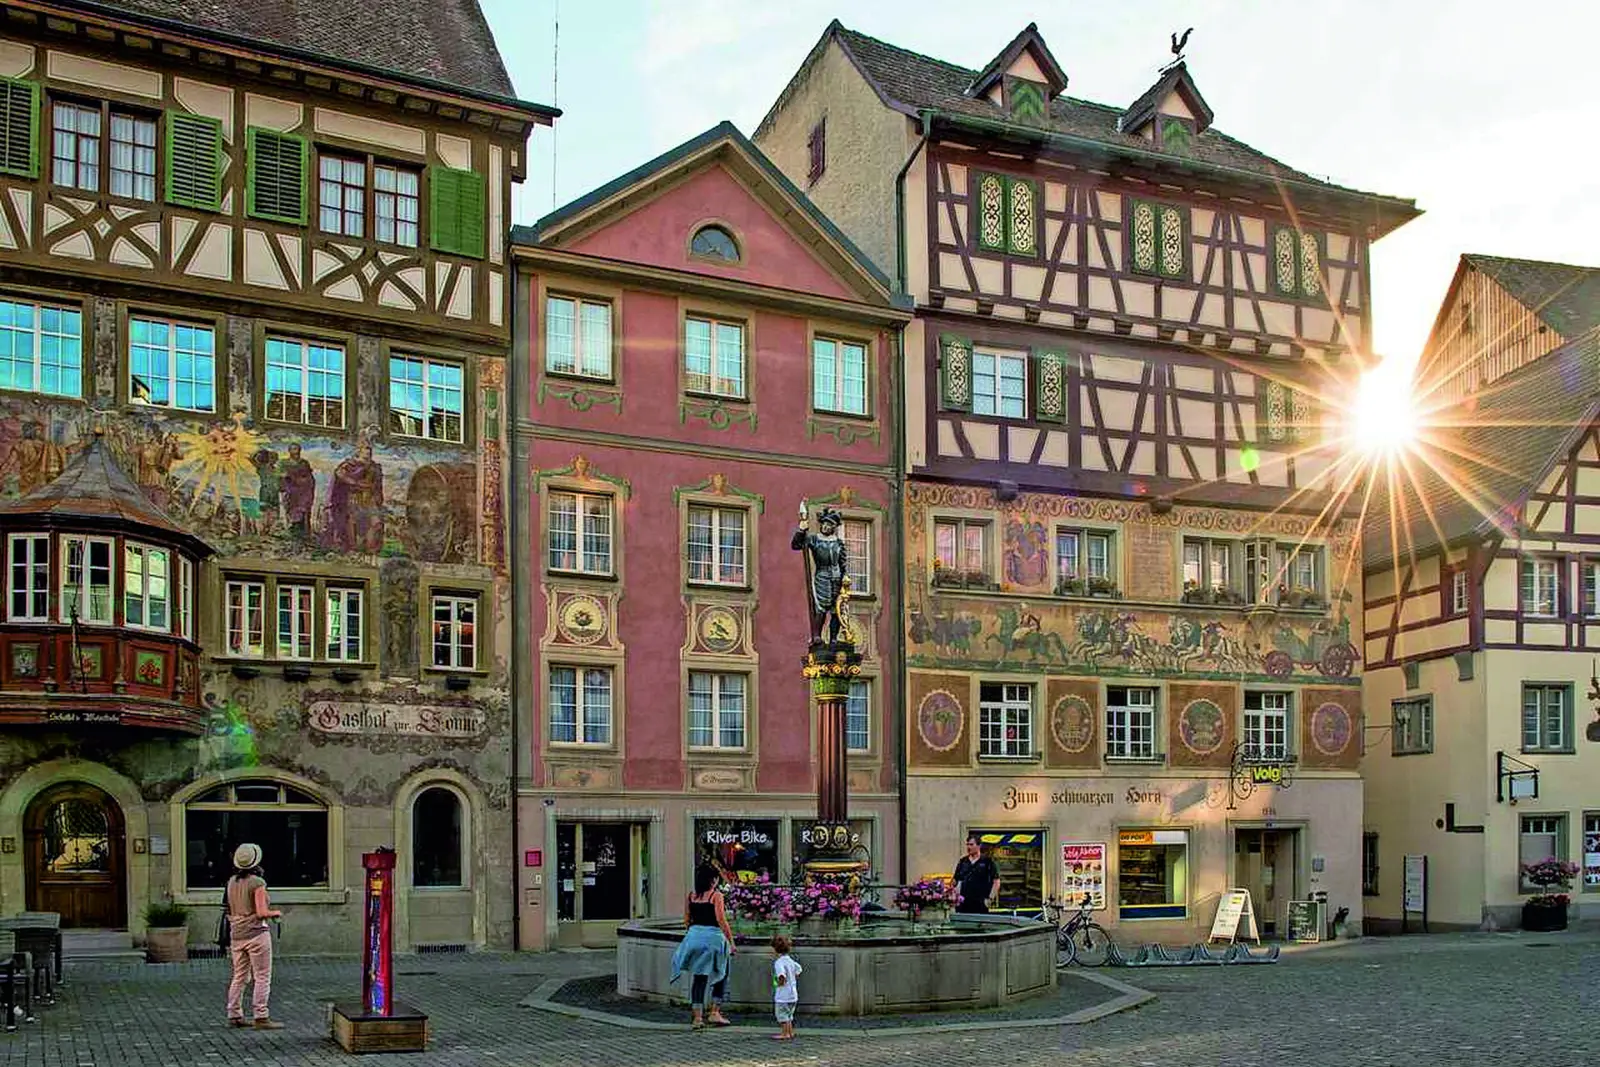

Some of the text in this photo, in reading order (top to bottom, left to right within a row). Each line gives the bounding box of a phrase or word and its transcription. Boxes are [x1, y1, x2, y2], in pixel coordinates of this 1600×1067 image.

[318, 704, 391, 730] Gasthof
[416, 707, 479, 733] Sonne
[1253, 765, 1281, 782] Volg
[1003, 785, 1161, 810] Zum schwarzen Horn
[706, 830, 768, 845] River Bike
